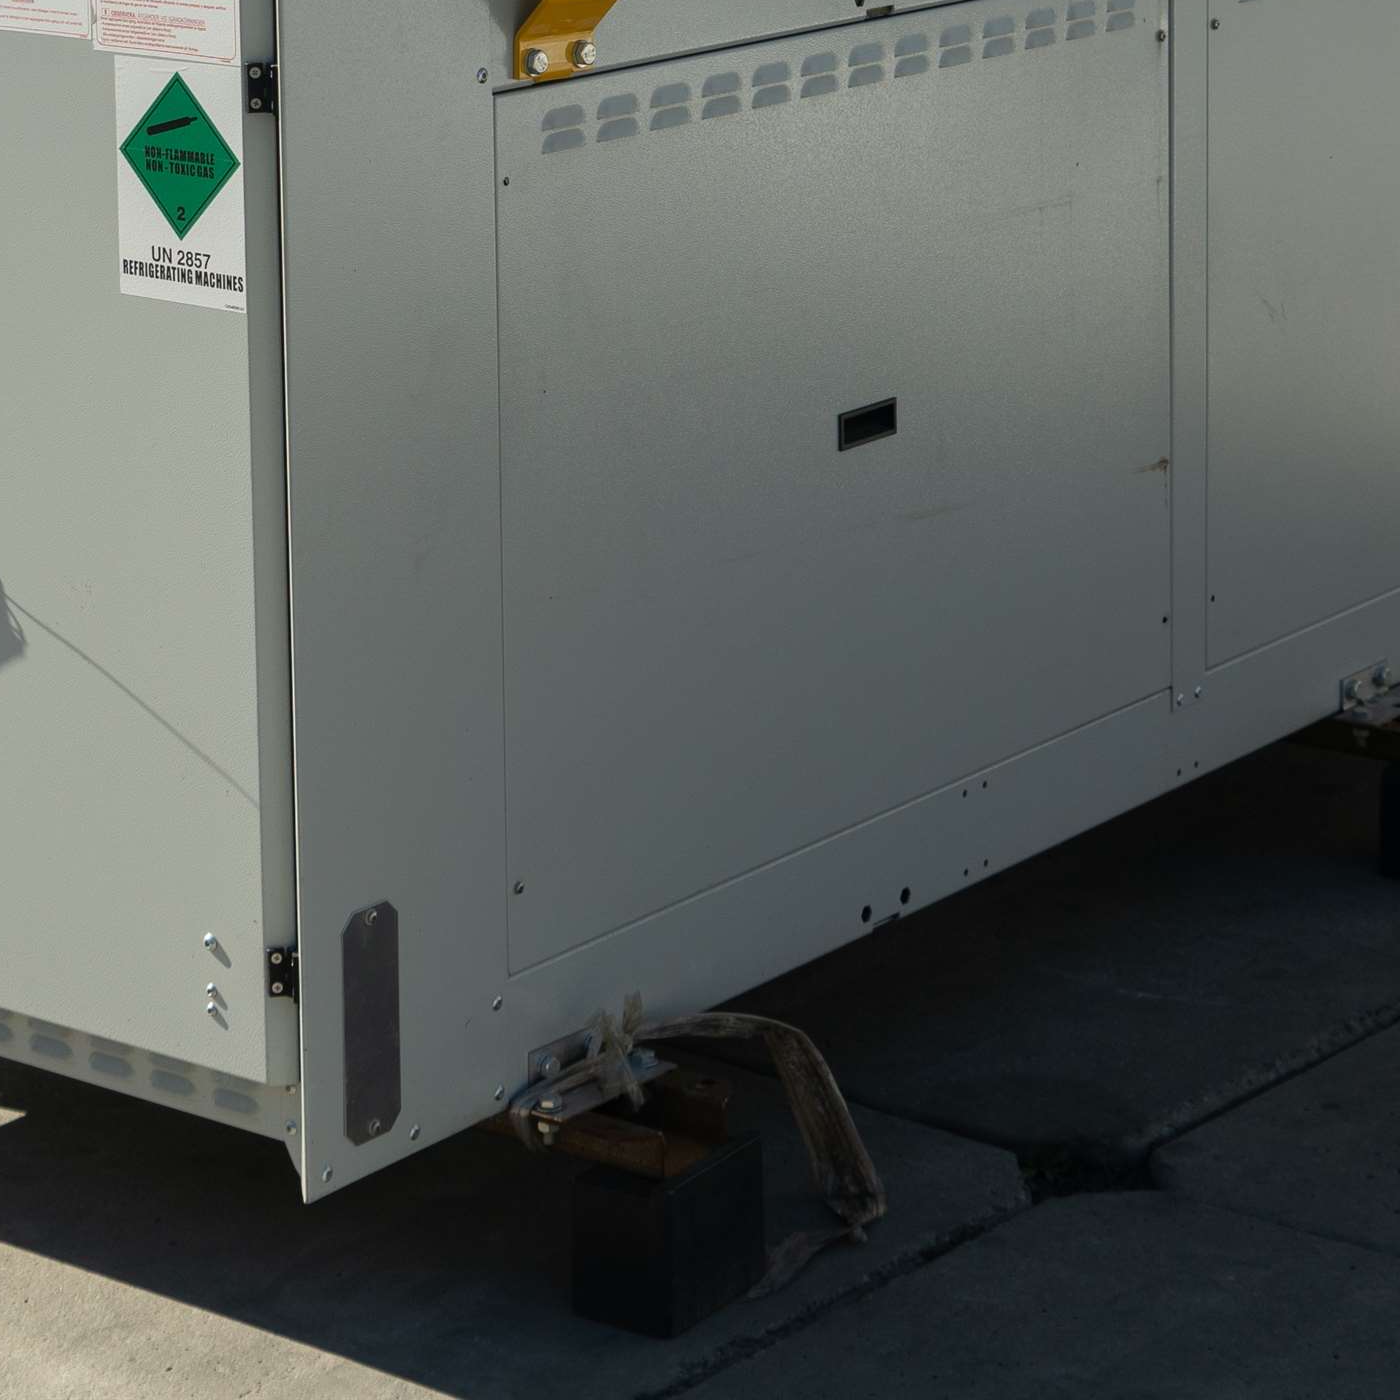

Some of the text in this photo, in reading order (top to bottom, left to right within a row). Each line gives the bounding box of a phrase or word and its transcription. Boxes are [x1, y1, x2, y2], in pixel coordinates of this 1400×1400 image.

[144, 145, 215, 165] NON-FLAMMABLE
[176, 206, 185, 221] 2
[152, 245, 211, 270] UN 2857
[123, 258, 244, 293] REFRIGERATING MACHINES
